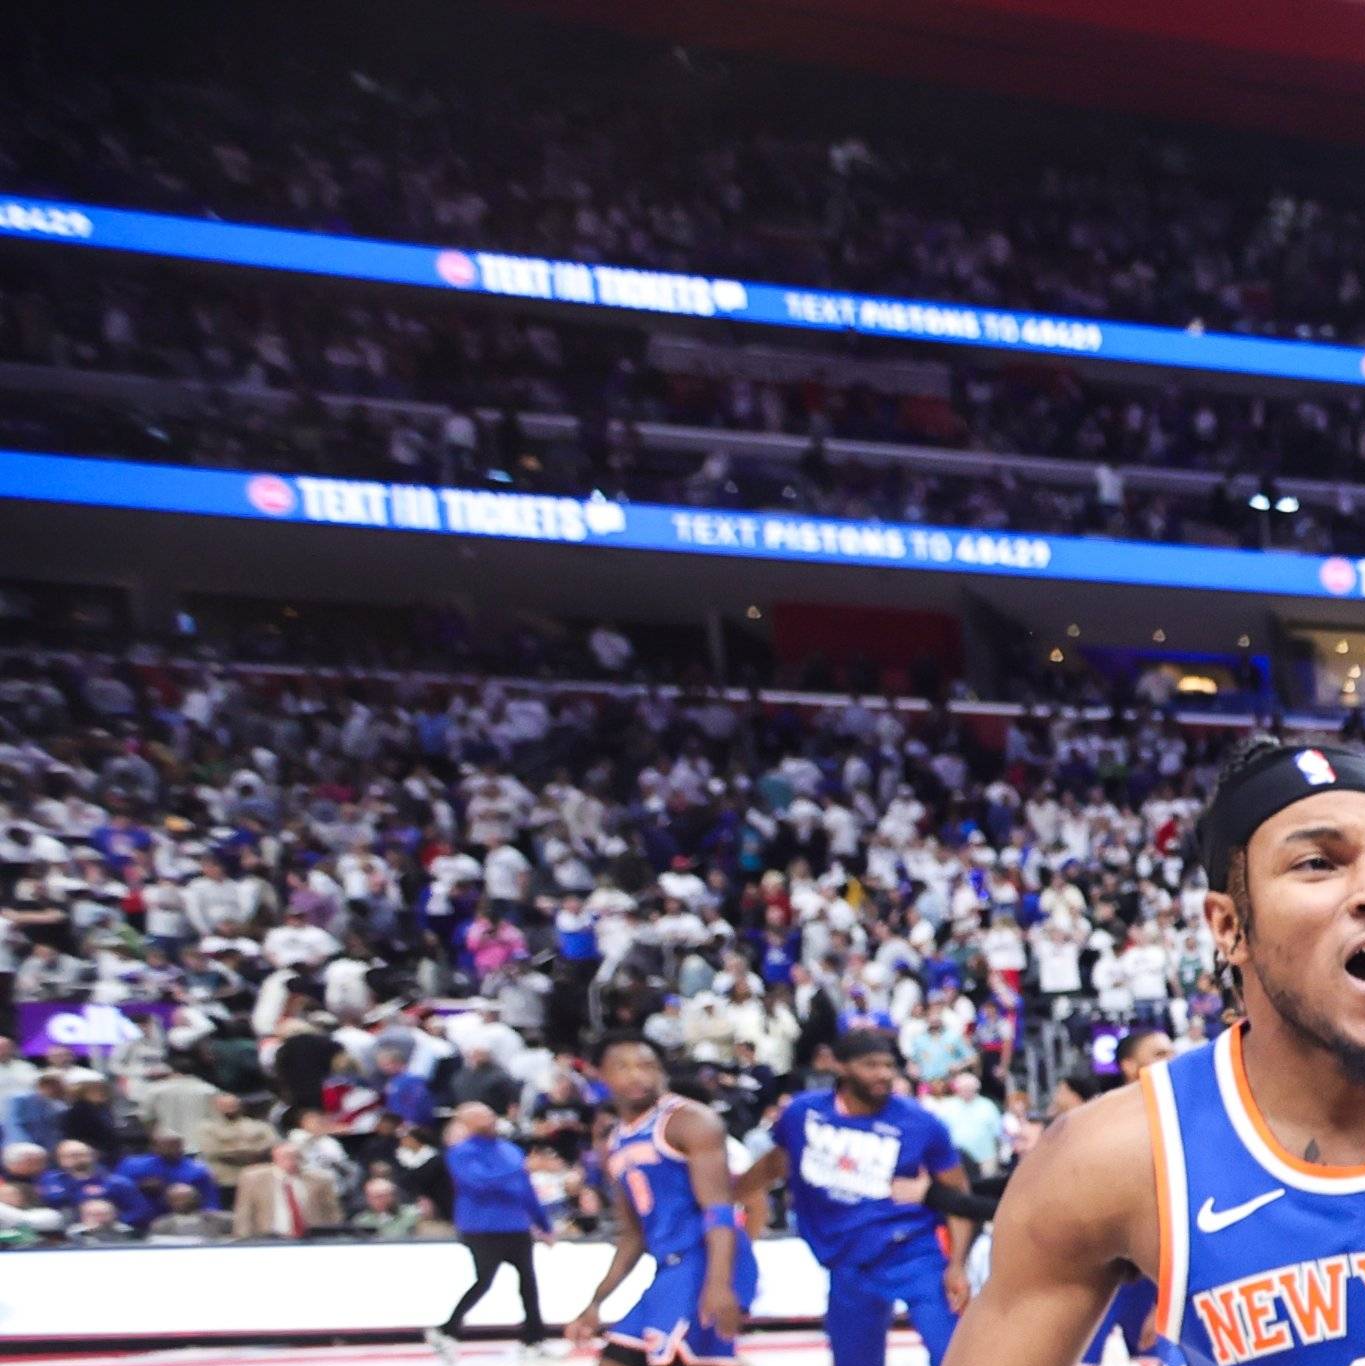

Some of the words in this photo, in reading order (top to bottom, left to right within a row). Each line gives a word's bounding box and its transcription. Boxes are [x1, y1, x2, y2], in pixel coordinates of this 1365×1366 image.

[784, 293, 856, 323] TEXT
[859, 302, 980, 339] PISTONS
[983, 315, 1019, 343] TO
[297, 477, 389, 525] TEXT
[443, 488, 588, 541] TICKETS
[671, 513, 758, 547] TEXT
[763, 520, 907, 559] PISTONS
[910, 531, 953, 562] TO
